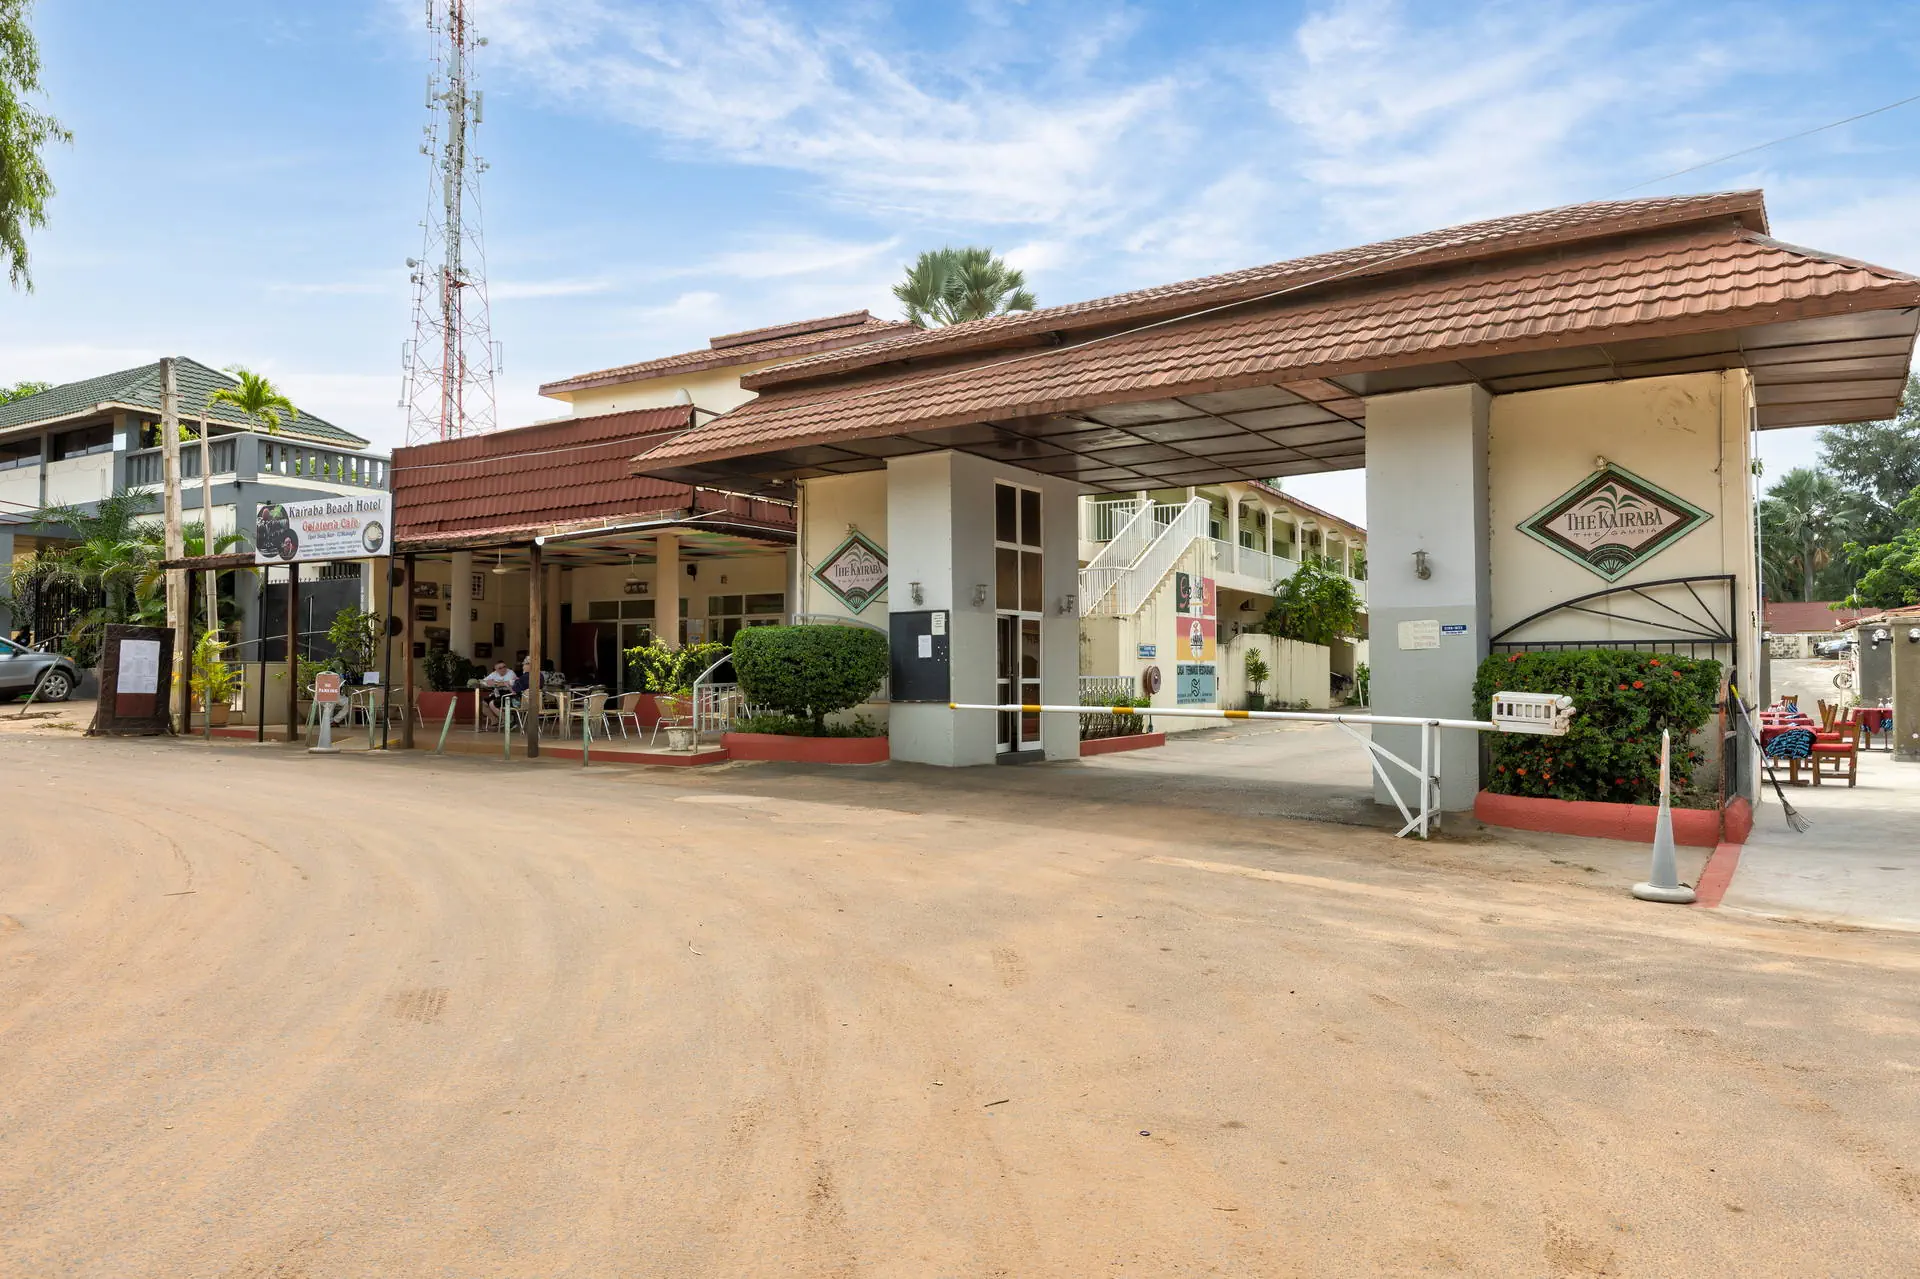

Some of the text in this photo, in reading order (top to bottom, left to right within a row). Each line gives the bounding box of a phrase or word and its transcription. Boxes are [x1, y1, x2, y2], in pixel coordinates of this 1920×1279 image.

[289, 498, 381, 518] Kairaba Beach Hotel
[1564, 507, 1663, 531] THE KAIRABA
[1611, 527, 1657, 537] GAMBIA
[850, 561, 883, 576] KAIRABA
